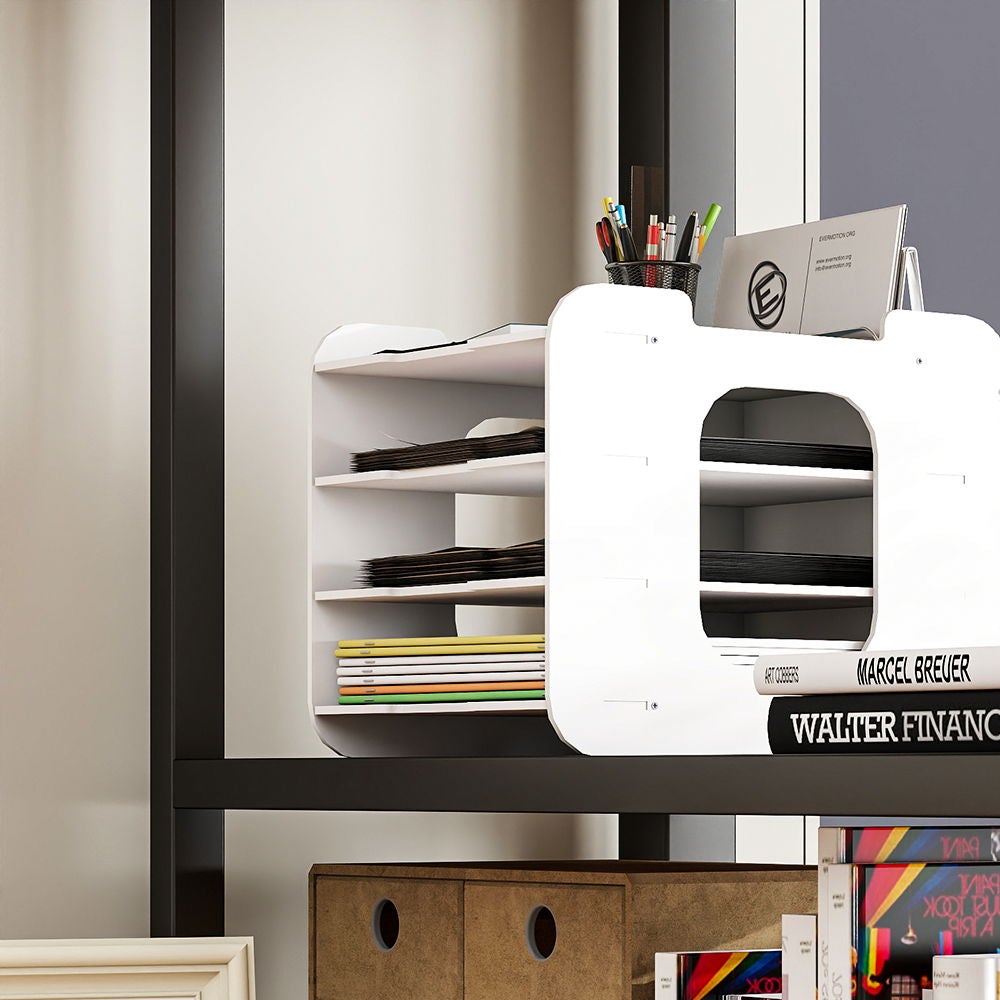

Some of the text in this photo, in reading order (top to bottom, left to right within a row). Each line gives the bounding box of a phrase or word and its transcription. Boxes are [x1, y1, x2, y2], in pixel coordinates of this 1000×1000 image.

[856, 654, 971, 686] MARCEL BREUER
[790, 712, 898, 744] WALTER
